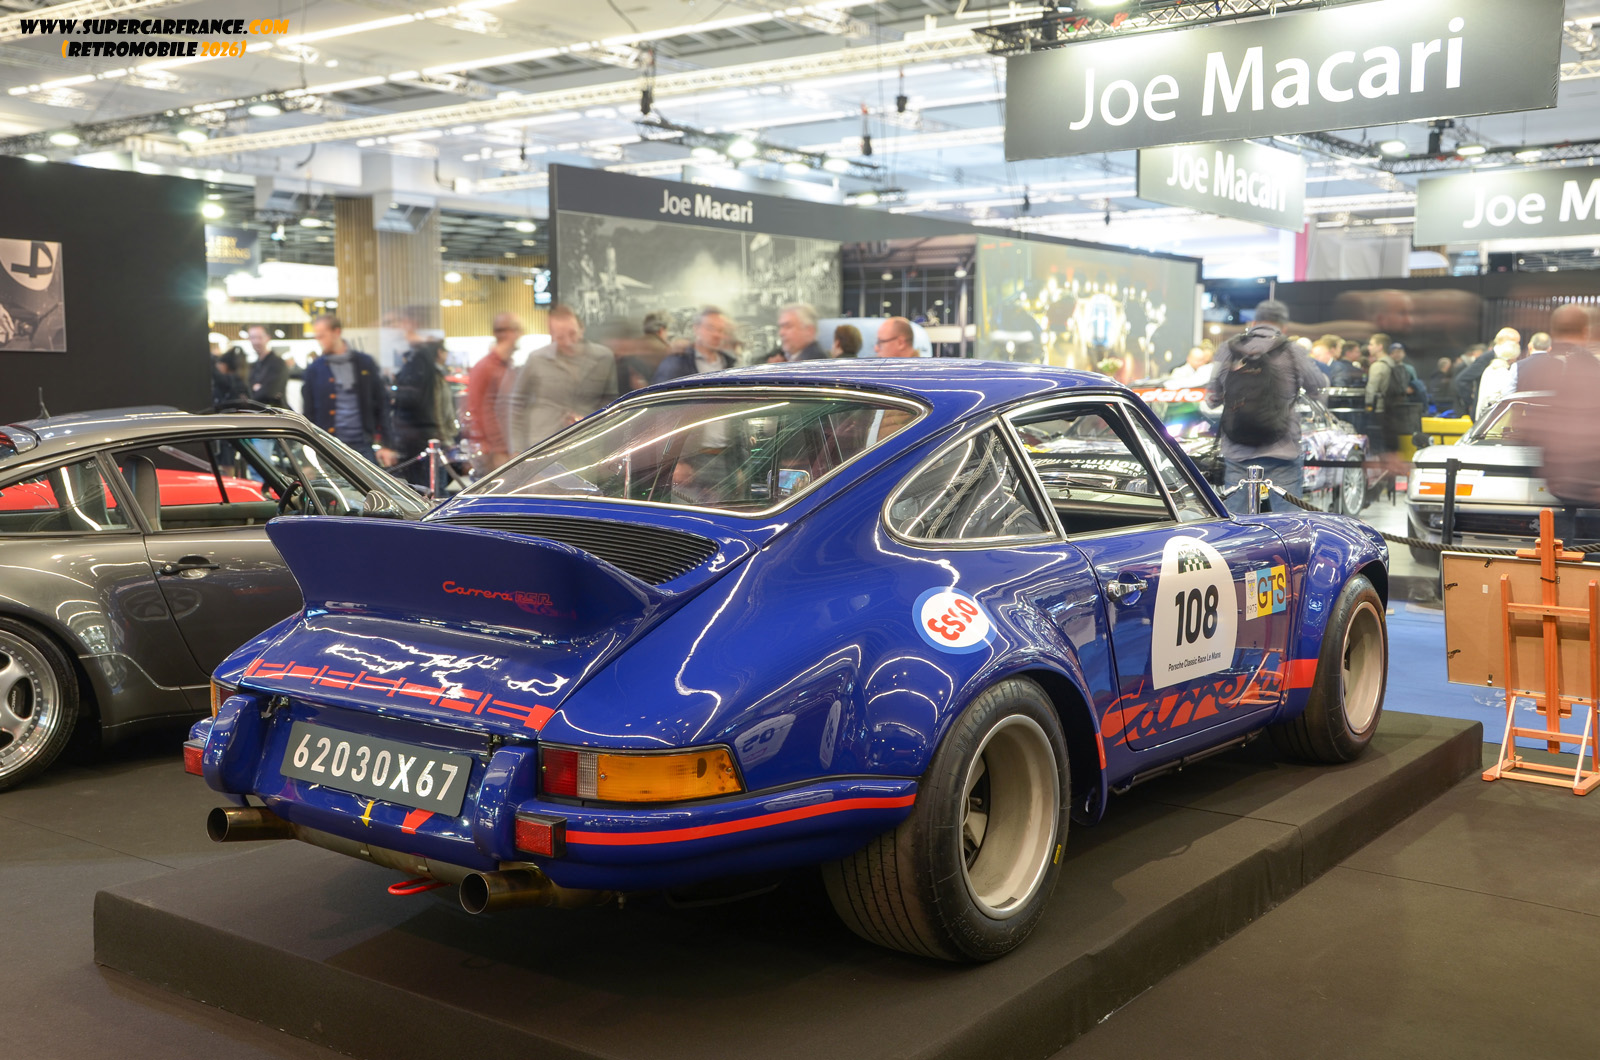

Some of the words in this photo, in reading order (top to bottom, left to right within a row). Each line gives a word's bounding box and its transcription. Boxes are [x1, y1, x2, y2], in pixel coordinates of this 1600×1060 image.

[1069, 67, 1180, 131] Joe
[1201, 17, 1465, 117] Macari
[1166, 147, 1209, 194] Joe
[1213, 150, 1287, 212] Macari
[659, 189, 692, 217] Joe
[694, 193, 753, 225] Macari
[1462, 183, 1546, 229] Joe
[442, 581, 513, 601] Carrera
[515, 591, 553, 606] RSR
[1257, 573, 1286, 609] GTS
[1174, 584, 1219, 647] 108
[1168, 663, 1184, 672] Porsche
[1184, 657, 1197, 668] Classic
[1197, 655, 1206, 664] Race
[1206, 653, 1211, 662] Le
[1211, 651, 1221, 659] Mans
[293, 734, 459, 801] 62030X67
